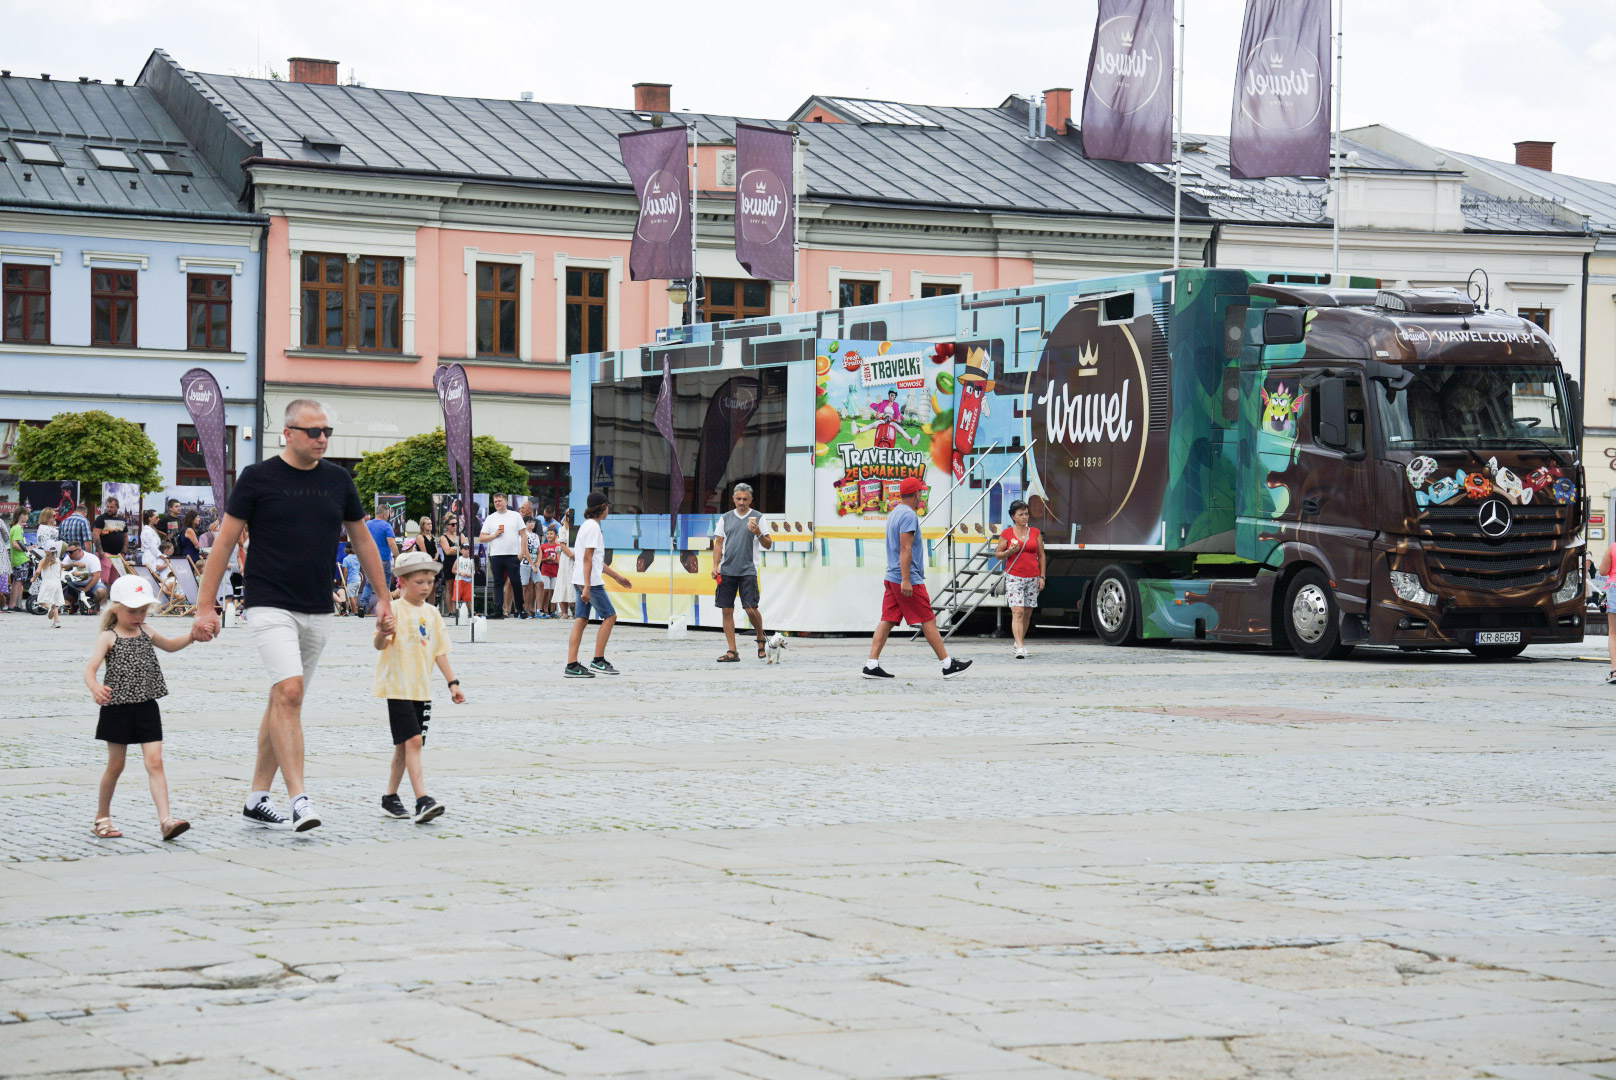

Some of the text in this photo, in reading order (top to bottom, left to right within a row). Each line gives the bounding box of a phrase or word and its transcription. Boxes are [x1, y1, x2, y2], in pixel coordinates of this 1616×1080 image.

[1434, 331, 1540, 344] WAWEL.COM.PL
[1037, 378, 1133, 444] Wawel
[1069, 457, 1102, 468] od 1898
[845, 468, 859, 480] ZE
[1480, 632, 1519, 643] KR 8EG35
